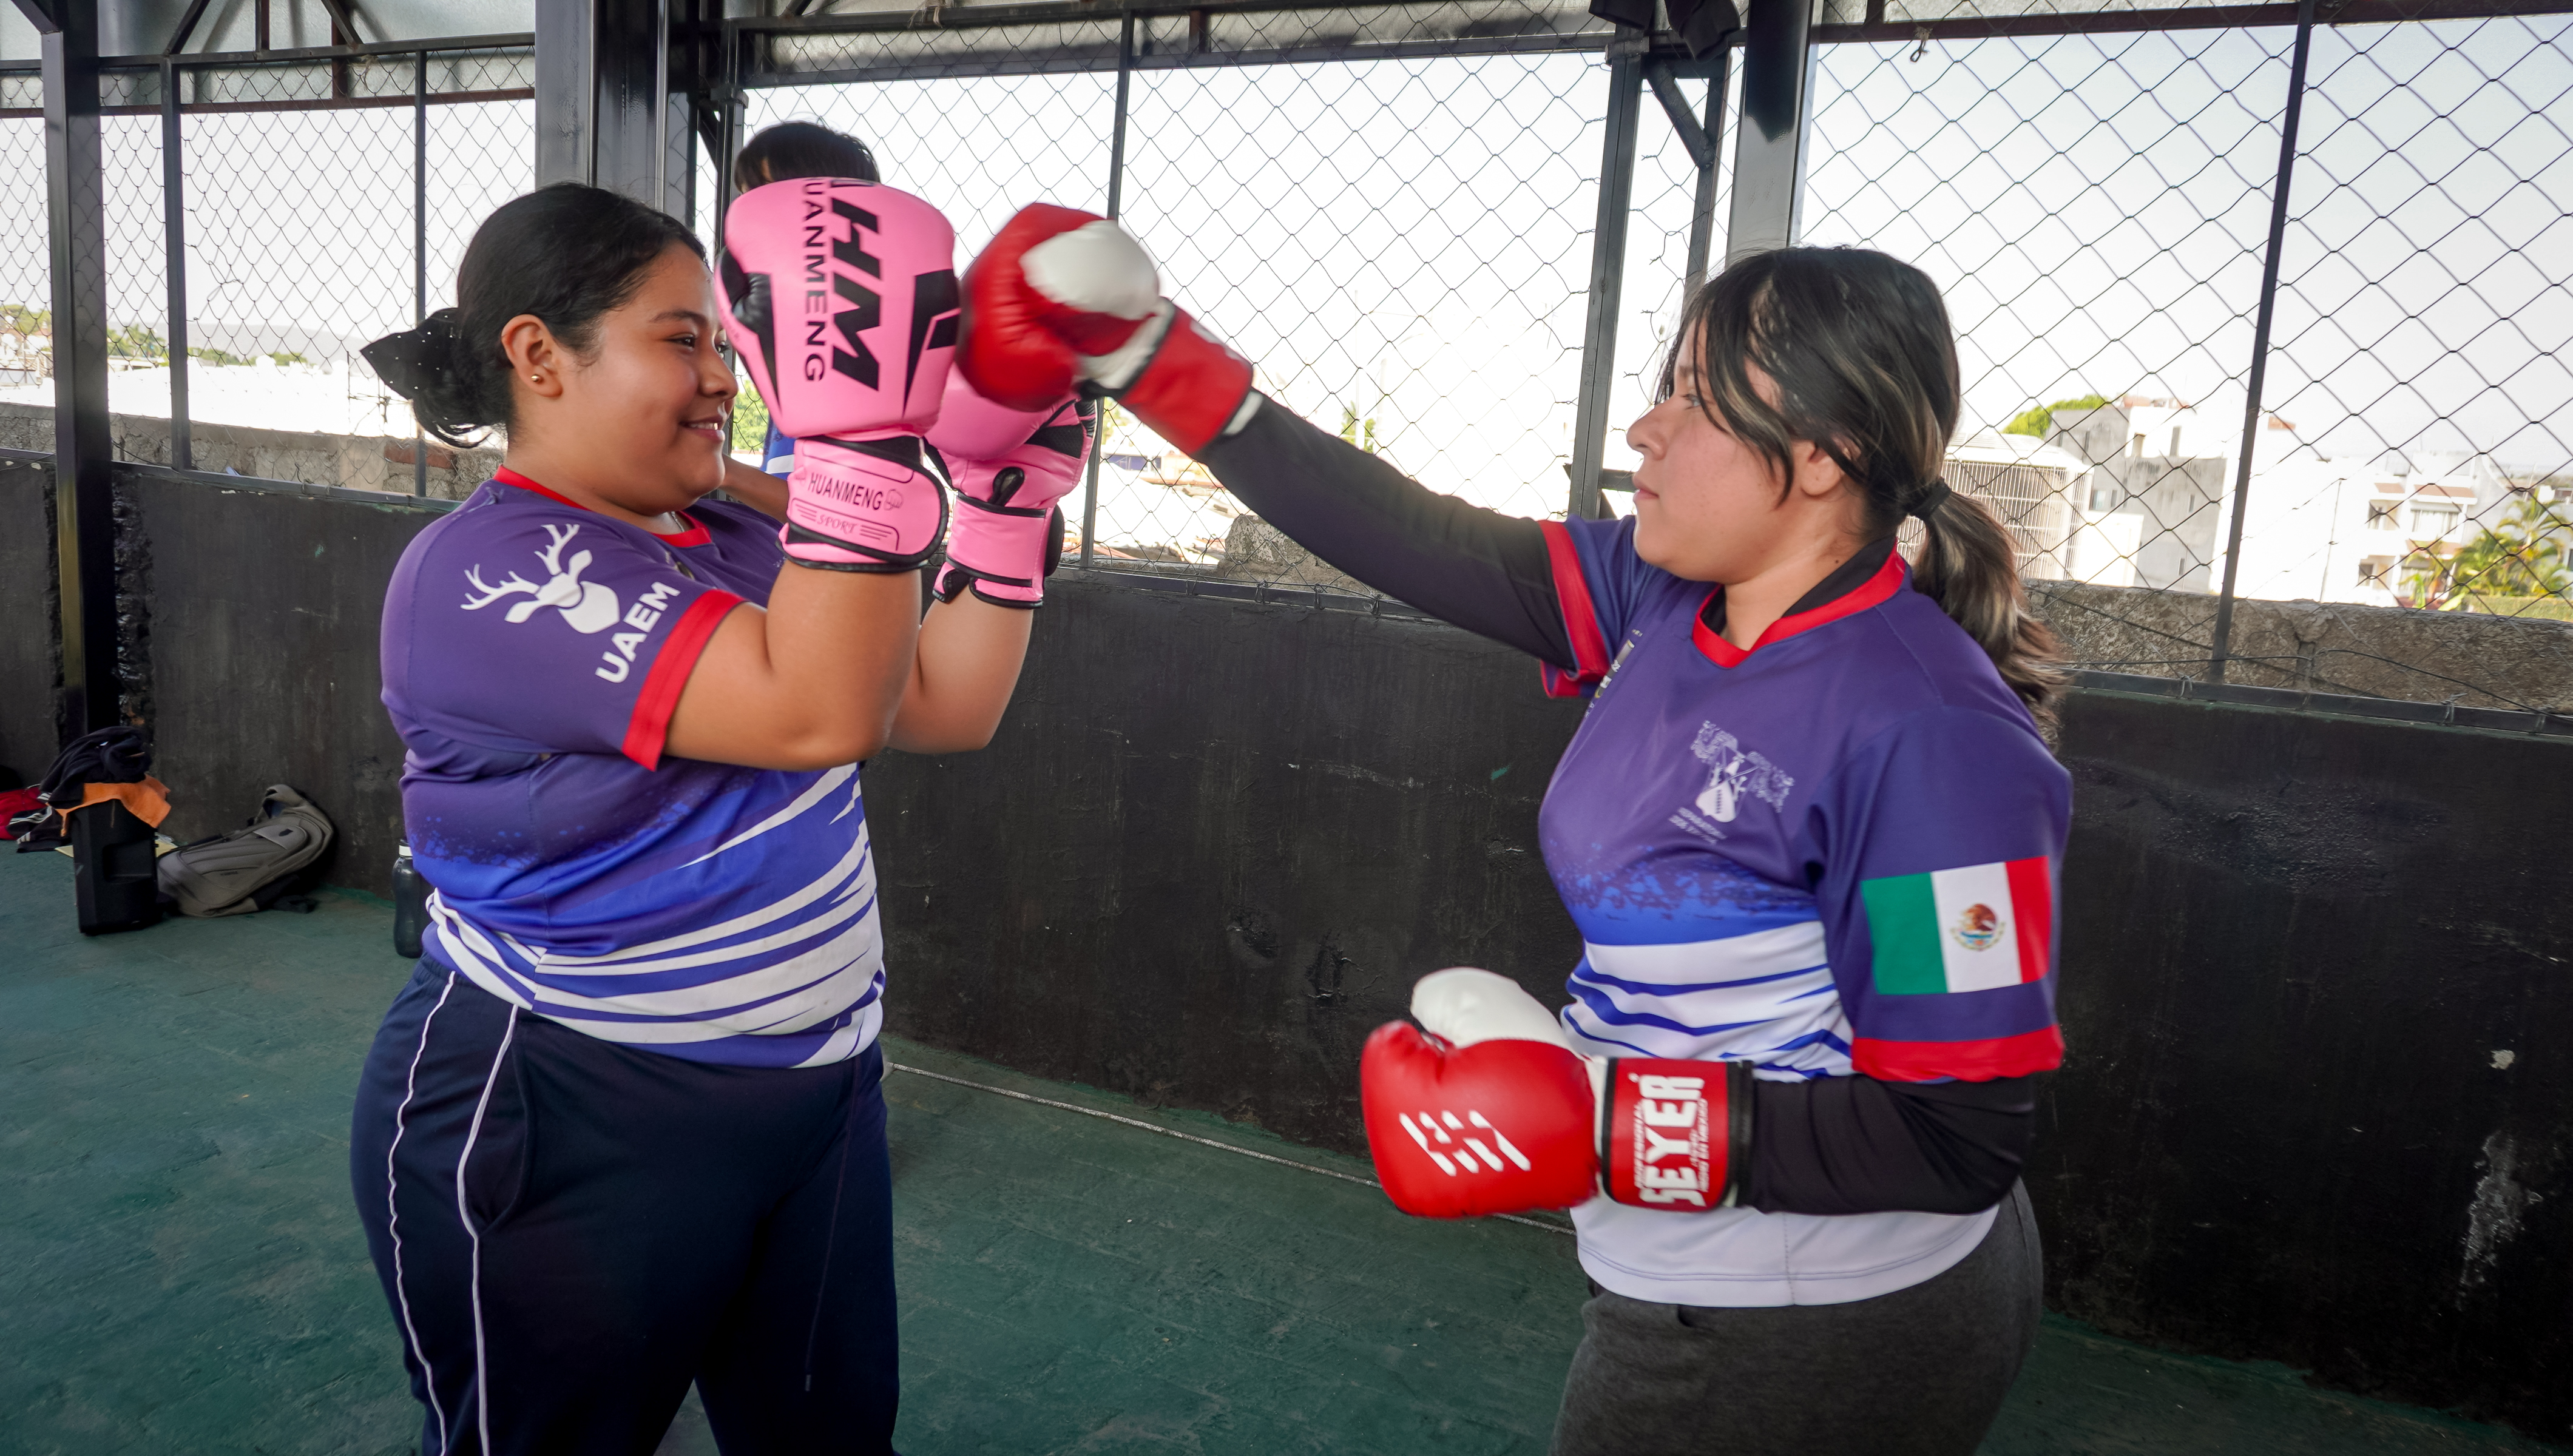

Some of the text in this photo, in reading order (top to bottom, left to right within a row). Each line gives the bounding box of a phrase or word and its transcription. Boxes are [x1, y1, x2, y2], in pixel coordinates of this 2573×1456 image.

[808, 472, 883, 510] HUANMENG
[817, 514, 857, 534] SPORT
[595, 582, 681, 683] UAEM
[1639, 1074, 1706, 1207] SEYER
